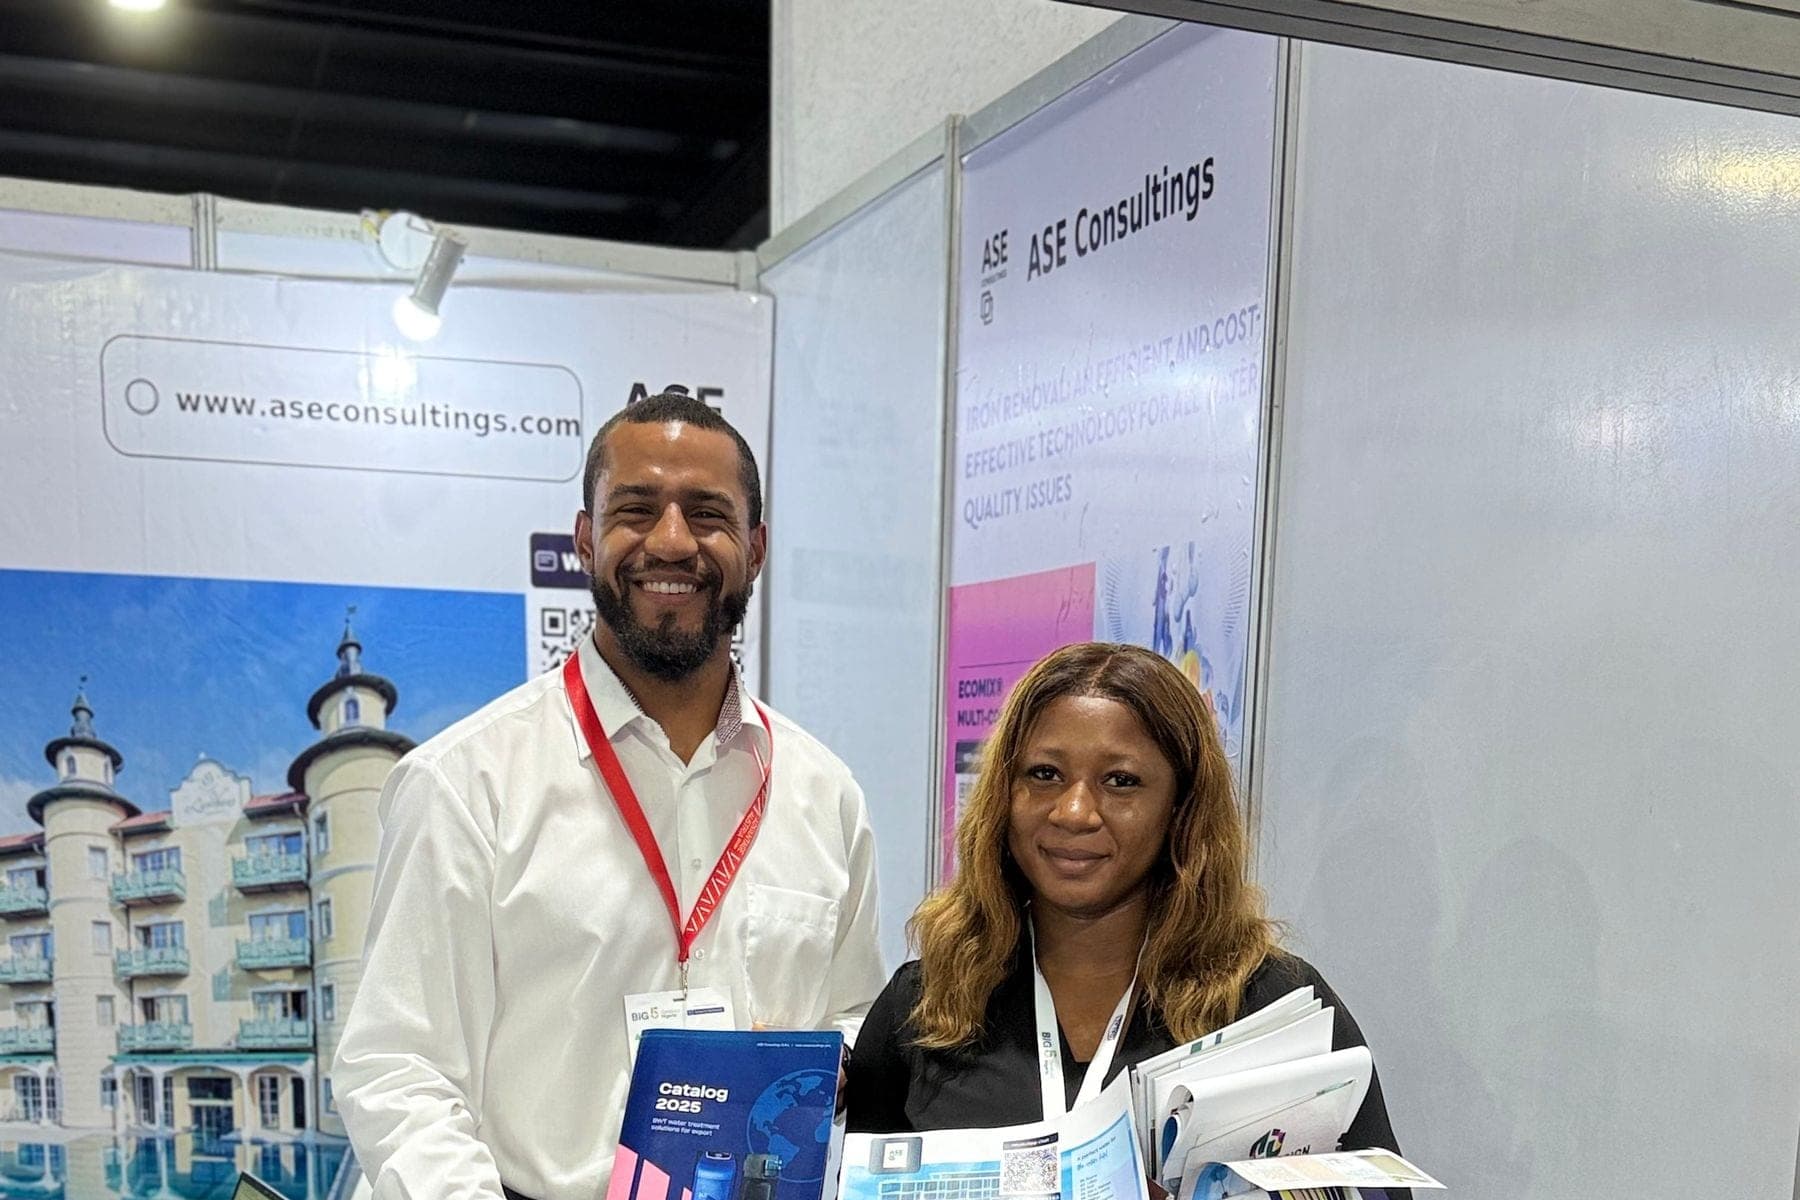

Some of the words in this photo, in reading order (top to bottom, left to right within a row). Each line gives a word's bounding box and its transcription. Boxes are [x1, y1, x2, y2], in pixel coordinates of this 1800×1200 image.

[1027, 219, 1067, 282] ASE
[1075, 157, 1214, 259] Consultings
[982, 229, 1008, 273] ASE
[1176, 325, 1210, 364] AND
[1212, 304, 1261, 350] COST-
[176, 388, 582, 438] www.aseconsultings.com
[965, 432, 1036, 479] EFFECTIVE
[1039, 407, 1138, 461] TECHNOLOGY
[1140, 393, 1169, 428] FOR
[963, 486, 1023, 530] QUALITY
[1026, 473, 1073, 512] ISSUES
[631, 1012, 649, 1021] BIG
[1041, 1031, 1052, 1048] BIG
[655, 1098, 702, 1113] 2025
[659, 1082, 729, 1102] Catalog
[651, 1124, 680, 1133] solutions
[681, 1126, 691, 1135] for
[691, 1128, 713, 1137] export
[652, 1117, 668, 1126] BWT
[668, 1118, 687, 1127] water
[687, 1120, 720, 1131] treatment
